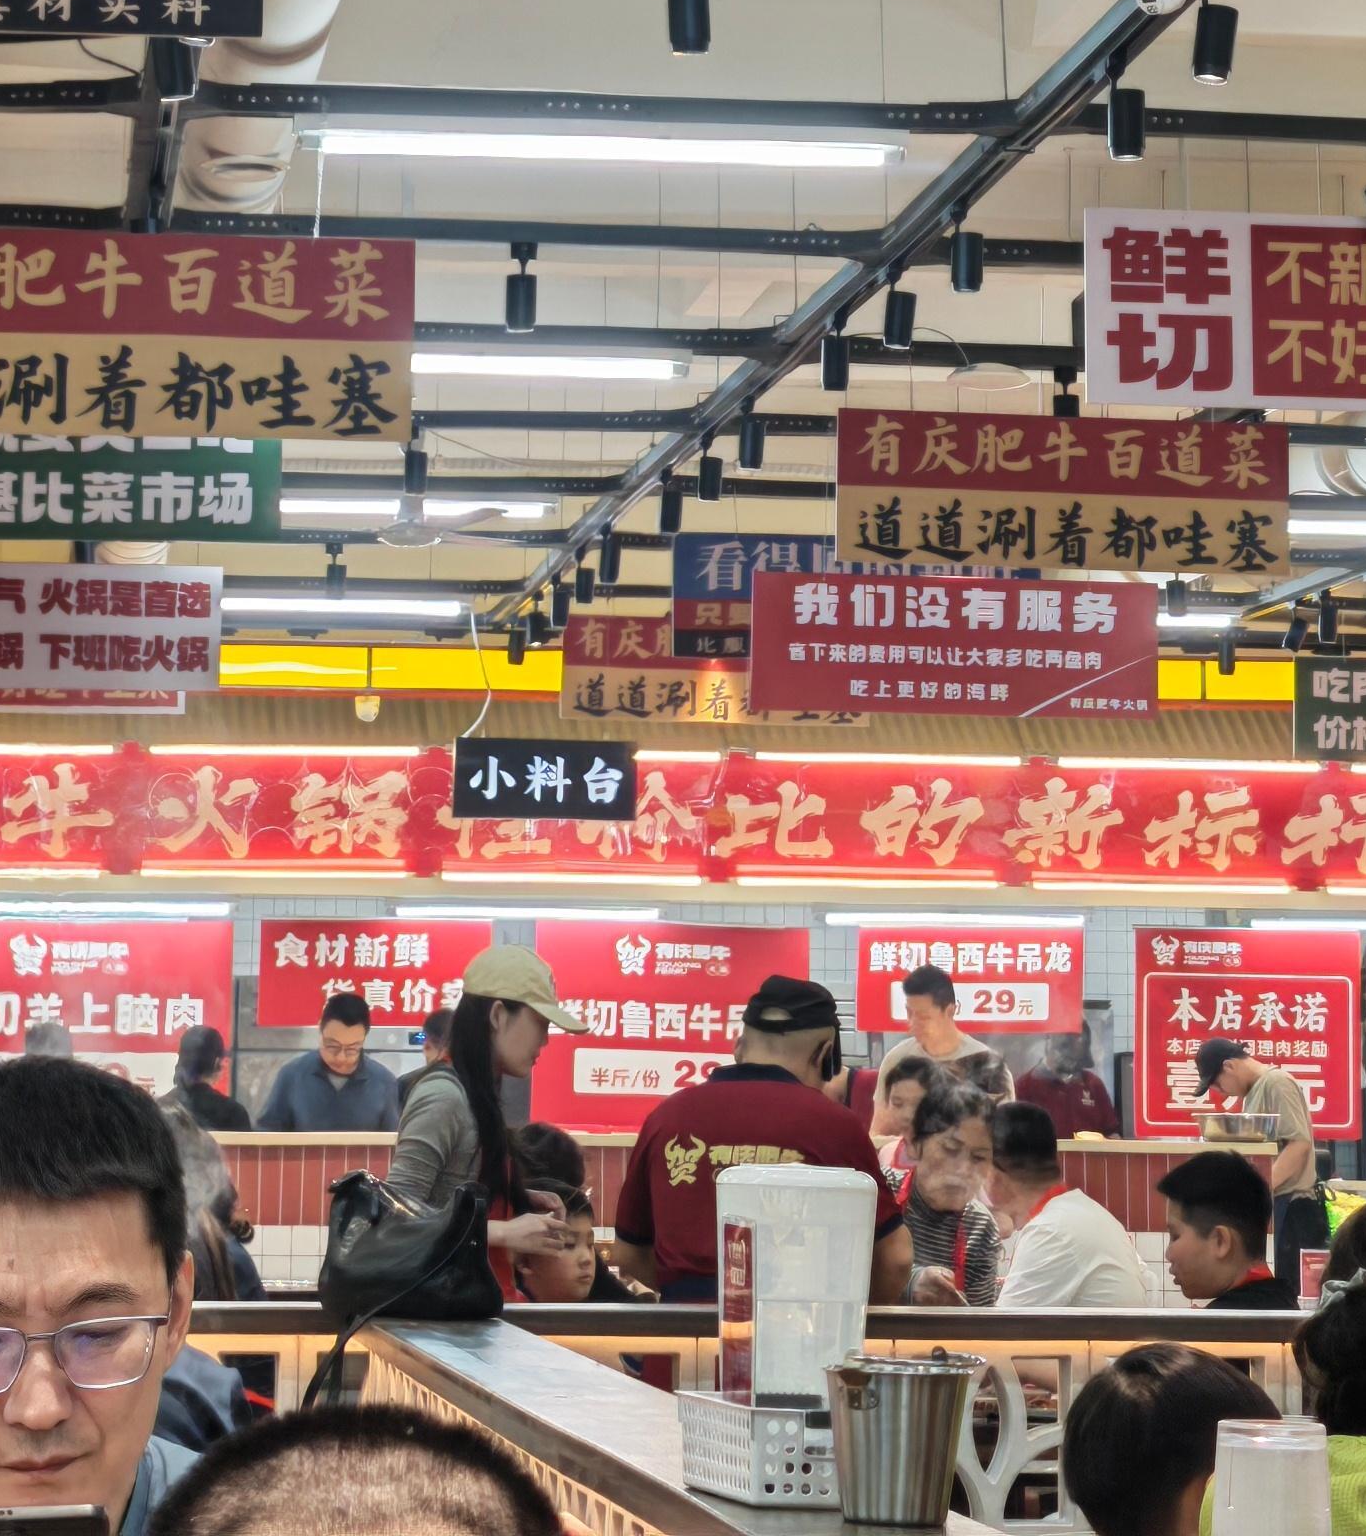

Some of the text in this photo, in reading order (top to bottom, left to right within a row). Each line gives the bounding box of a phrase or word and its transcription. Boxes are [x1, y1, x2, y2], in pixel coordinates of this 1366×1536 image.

[1103, 225, 1232, 393] 鲜切
[856, 415, 1270, 490] 有庆肥牛百道菜
[855, 497, 1279, 571] 道道涮着都哇塞
[39, 578, 211, 618] 火锅是首选
[793, 583, 1118, 634] 我们没有服务
[39, 633, 210, 673] 下班吃火锅
[849, 680, 1009, 702] 吃上更好的海鲜
[469, 756, 623, 804] 小料台
[274, 932, 430, 968] 食材新鲜
[869, 941, 1072, 974] 鲜切鲁西牛吊龙
[1168, 988, 1329, 1032] 本店承诺
[590, 1068, 661, 1088] 半斤/份
